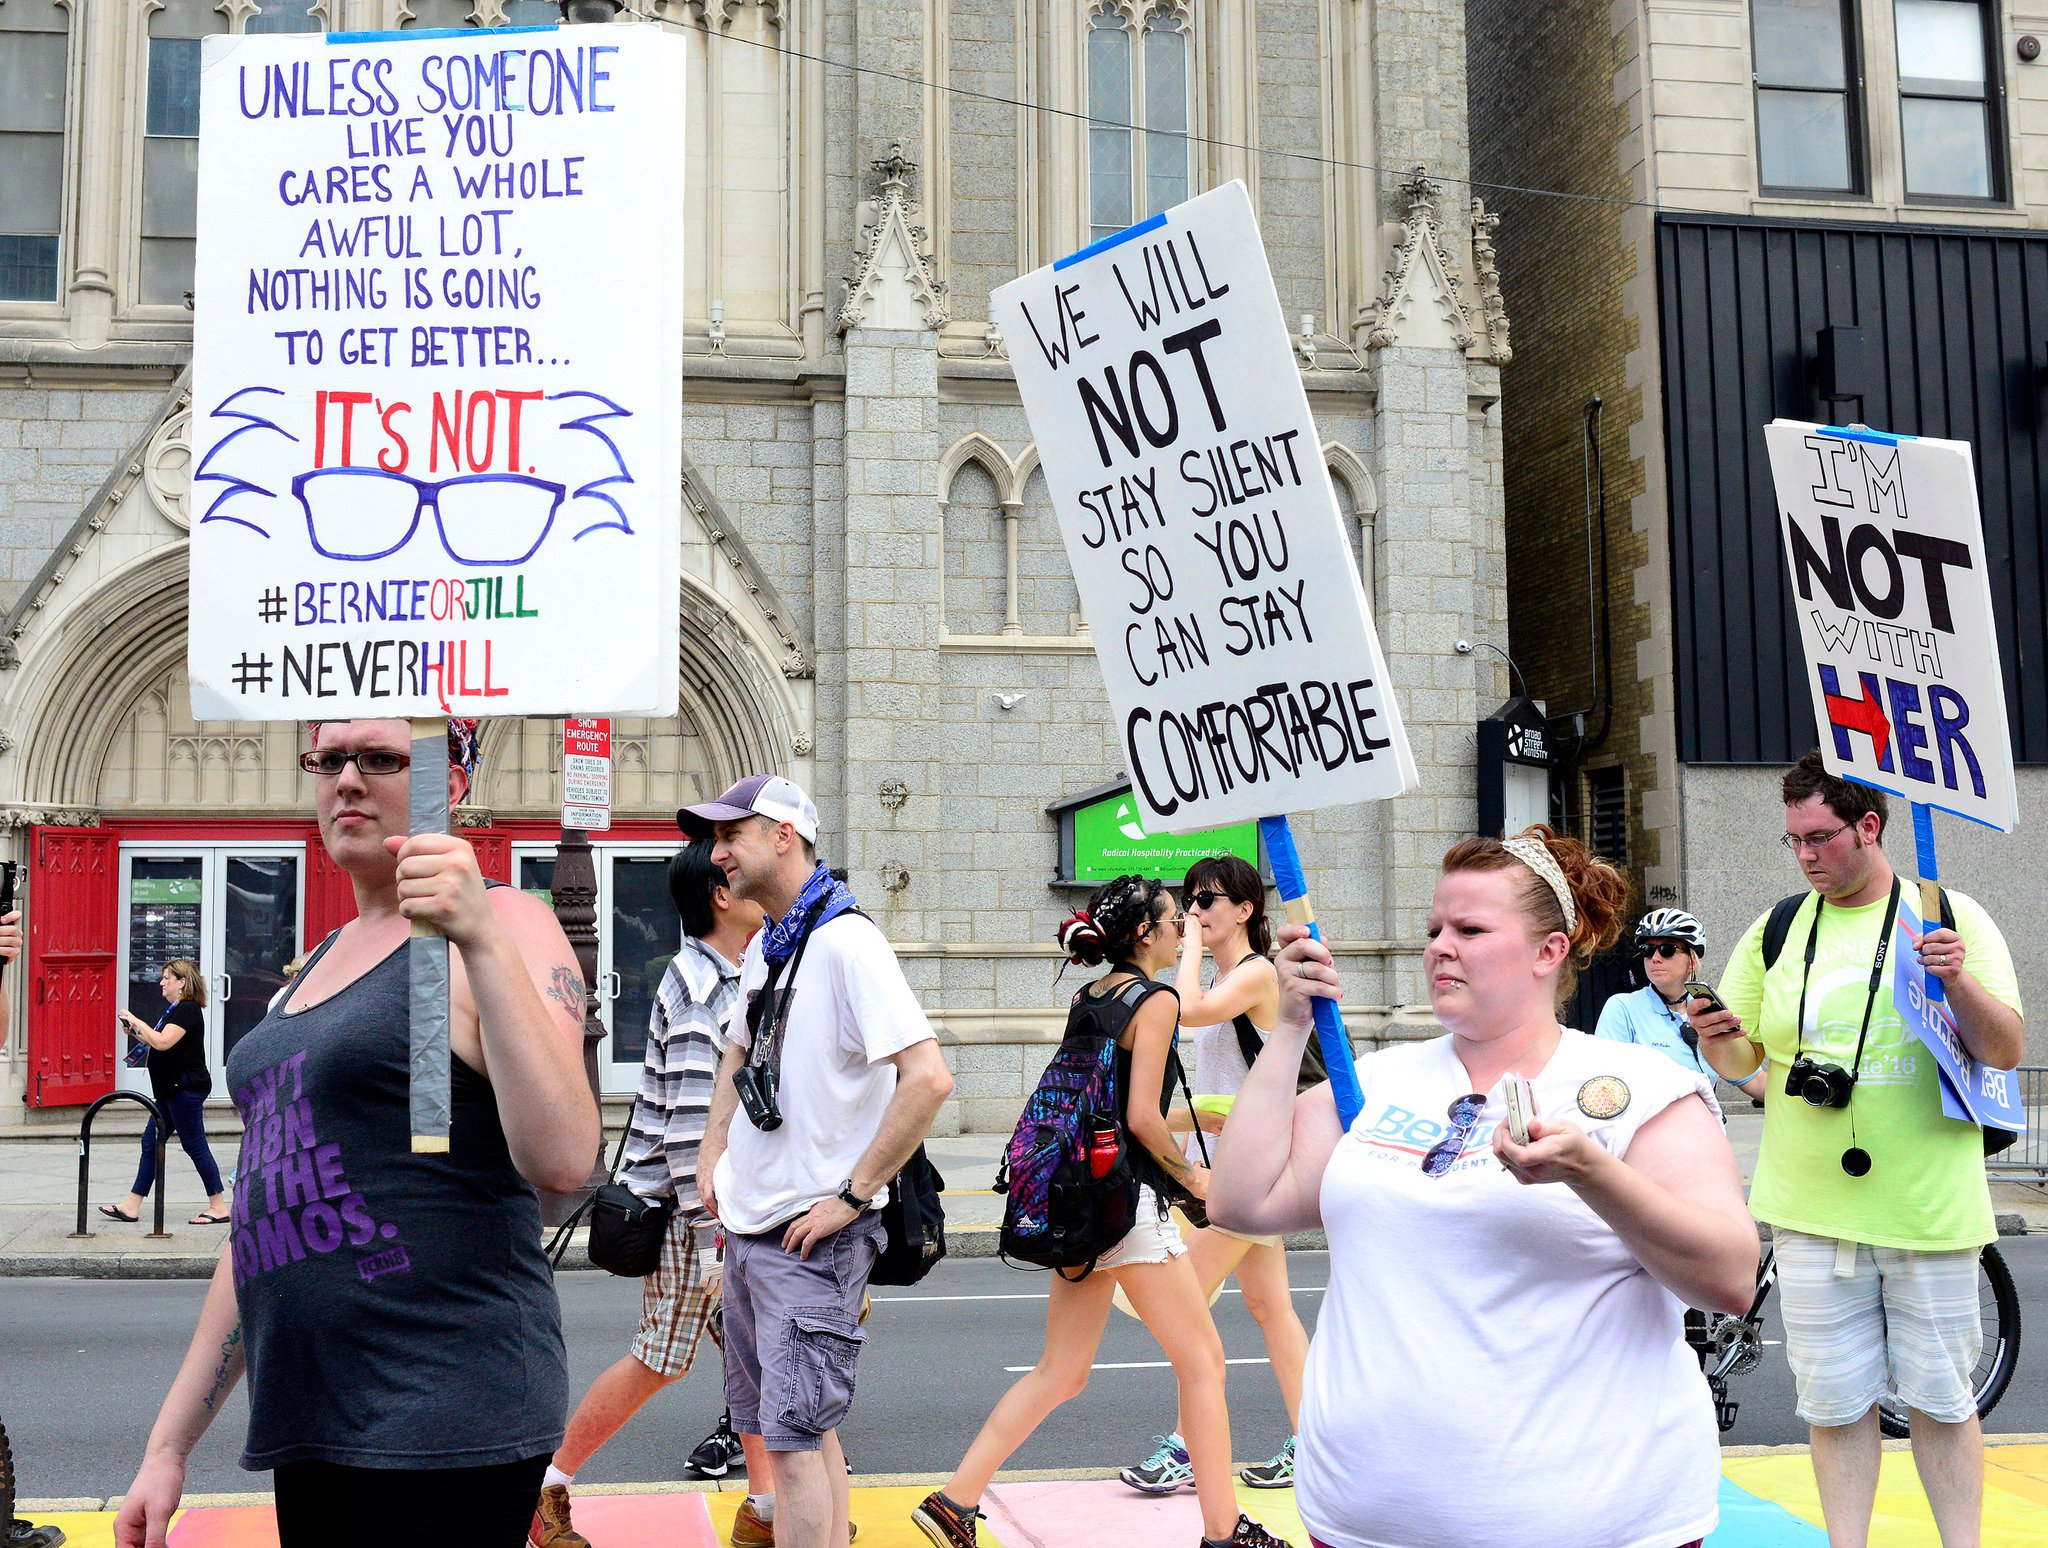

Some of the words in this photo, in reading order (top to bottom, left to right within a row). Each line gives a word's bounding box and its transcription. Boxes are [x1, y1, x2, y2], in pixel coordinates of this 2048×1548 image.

[240, 59, 398, 119] UNLESS
[417, 46, 619, 114] SOMEONE
[347, 117, 426, 159] LIKE
[443, 114, 513, 158] YOU
[279, 164, 392, 206] CARES
[408, 165, 433, 202] A
[453, 156, 585, 199] WHOLE
[299, 215, 422, 259] AWFUL
[439, 210, 522, 259] LOT,
[247, 268, 387, 314] NOTHING
[405, 267, 433, 309] IS
[443, 266, 541, 309] GOING
[1020, 284, 1100, 371] WE
[1112, 230, 1230, 332] WILL
[275, 330, 323, 365] TO
[340, 326, 398, 367] GET
[410, 326, 570, 367] BETTER...
[1076, 318, 1227, 468] NOT
[314, 390, 411, 473] IT'S
[429, 389, 544, 474] NOT.
[1078, 467, 1165, 548] STAY
[1179, 429, 1302, 517] SILENT
[1804, 434, 1908, 519] I'M
[1121, 544, 1174, 615] SO
[1193, 510, 1289, 588] YOU
[1788, 511, 1973, 635] NOT
[258, 575, 538, 626] #BERNIEORJILL
[1125, 613, 1210, 687] CAN
[1220, 579, 1313, 656] STAY
[232, 638, 508, 699] #NEVERHILL
[1810, 609, 1944, 679] WITH
[566, 730, 608, 742] EMERGENCY
[576, 742, 598, 752] ROUTE
[578, 718, 598, 728] SNOW
[1127, 678, 1391, 817] COMFORTABLE
[1816, 662, 1987, 799] HER
[1102, 848, 1130, 856] Radical
[1132, 848, 1174, 858] Hospitality
[1176, 848, 1210, 857] Practiced
[1875, 940, 1887, 969] SONY
[261, 1142, 351, 1214] THE
[1367, 1150, 1400, 1162] FOR
